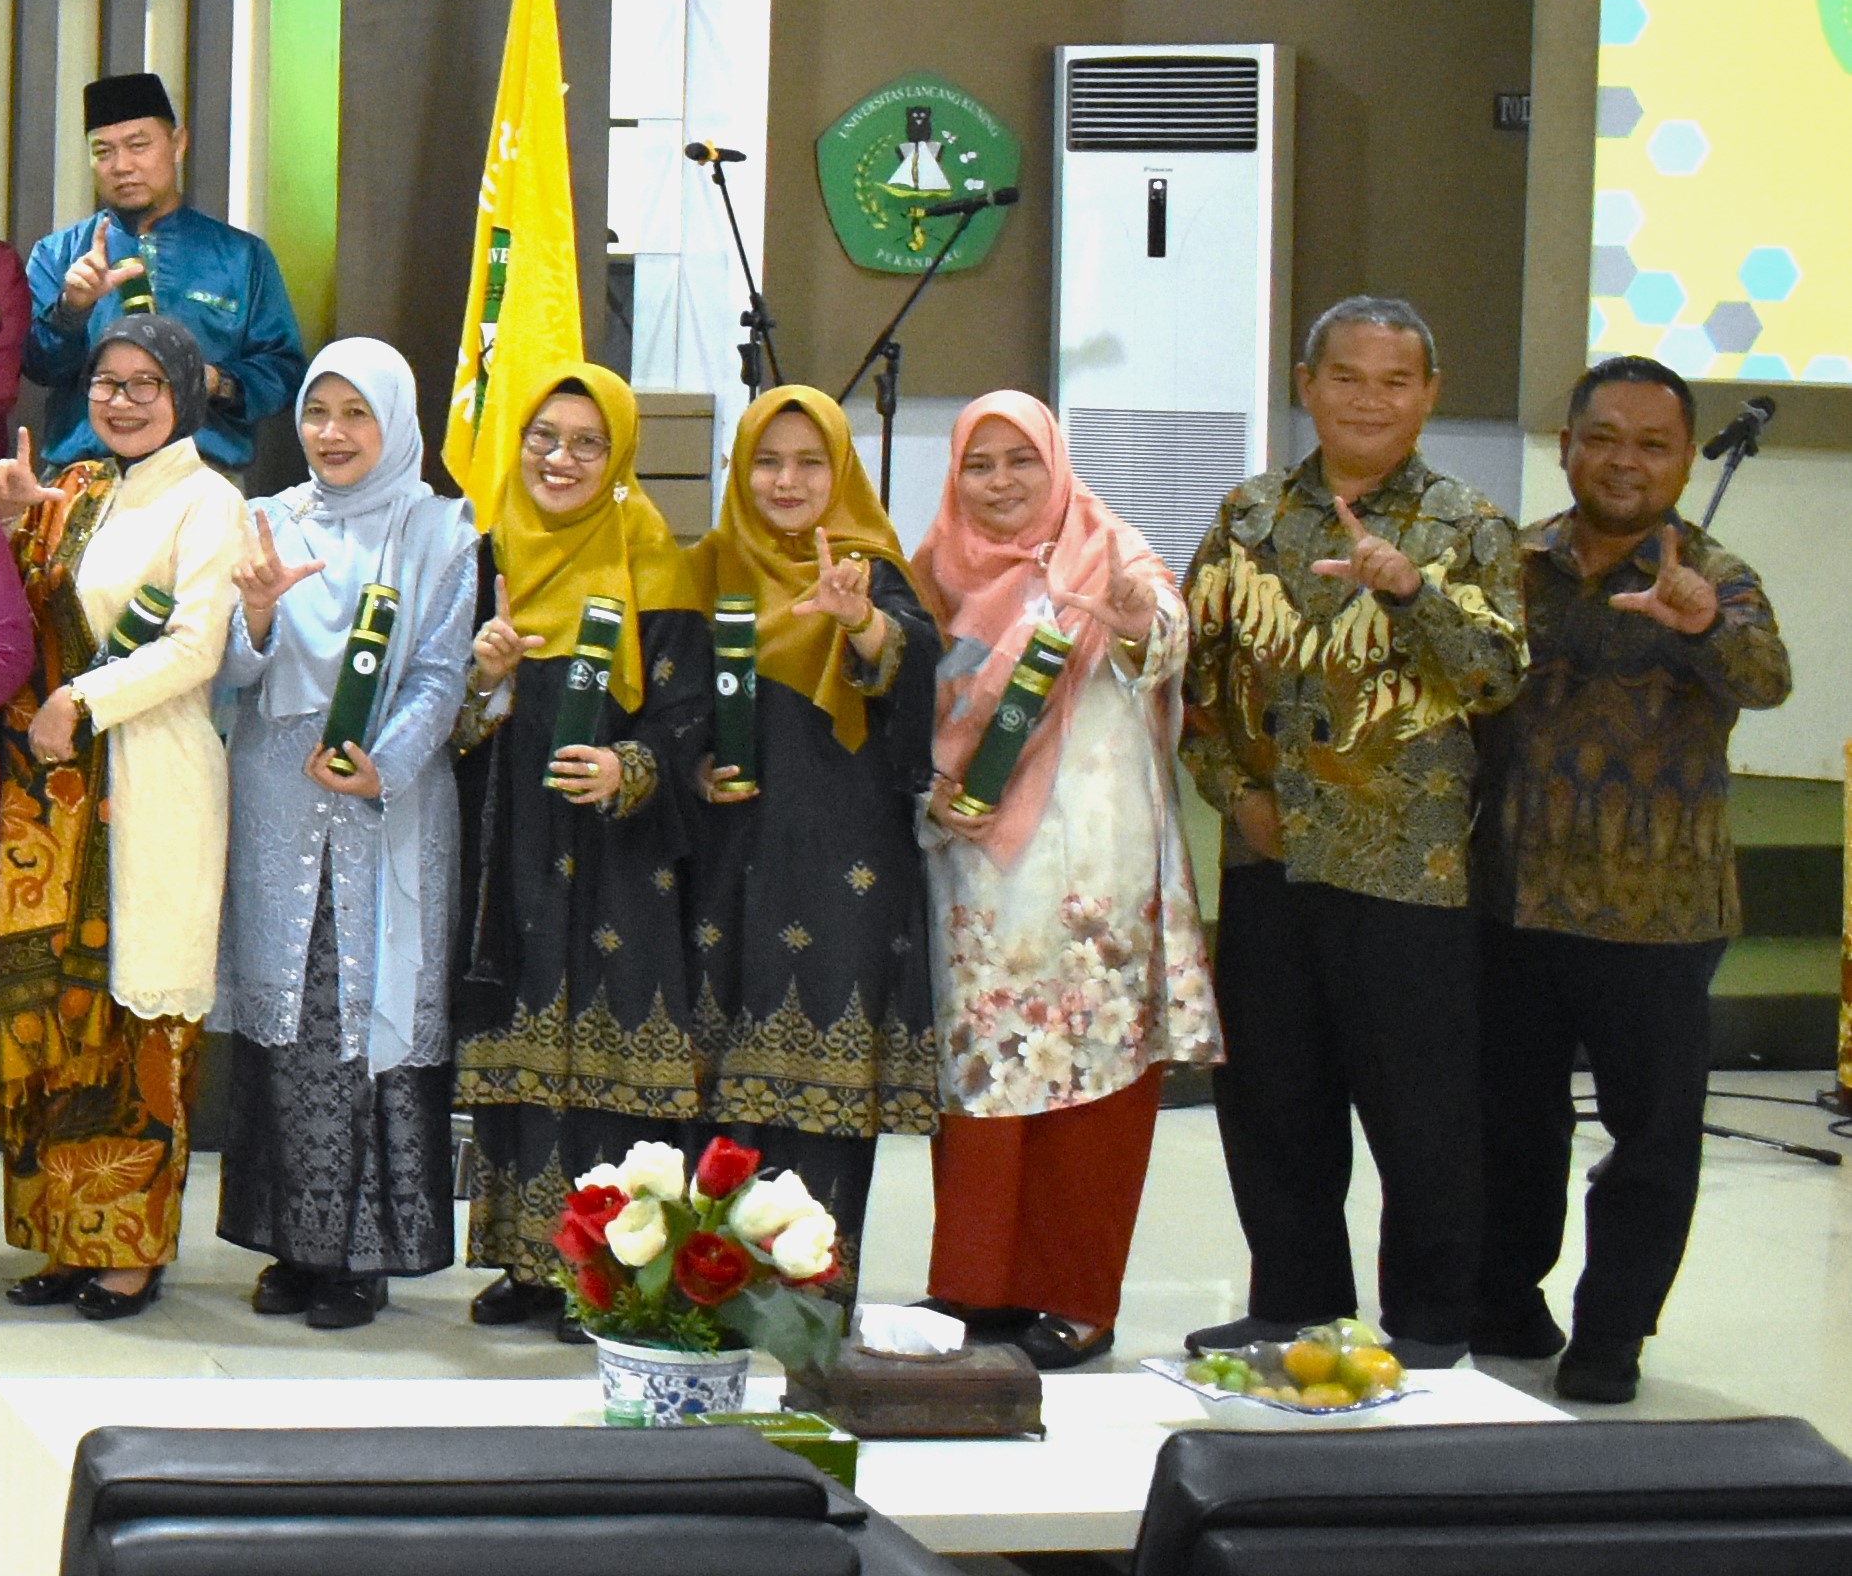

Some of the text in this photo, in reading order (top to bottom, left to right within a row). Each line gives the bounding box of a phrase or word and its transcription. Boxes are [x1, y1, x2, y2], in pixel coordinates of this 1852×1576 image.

[838, 85, 999, 139] UNIVERSITAS LANCANG KUNING
[875, 247, 963, 268] PEKANBRU
